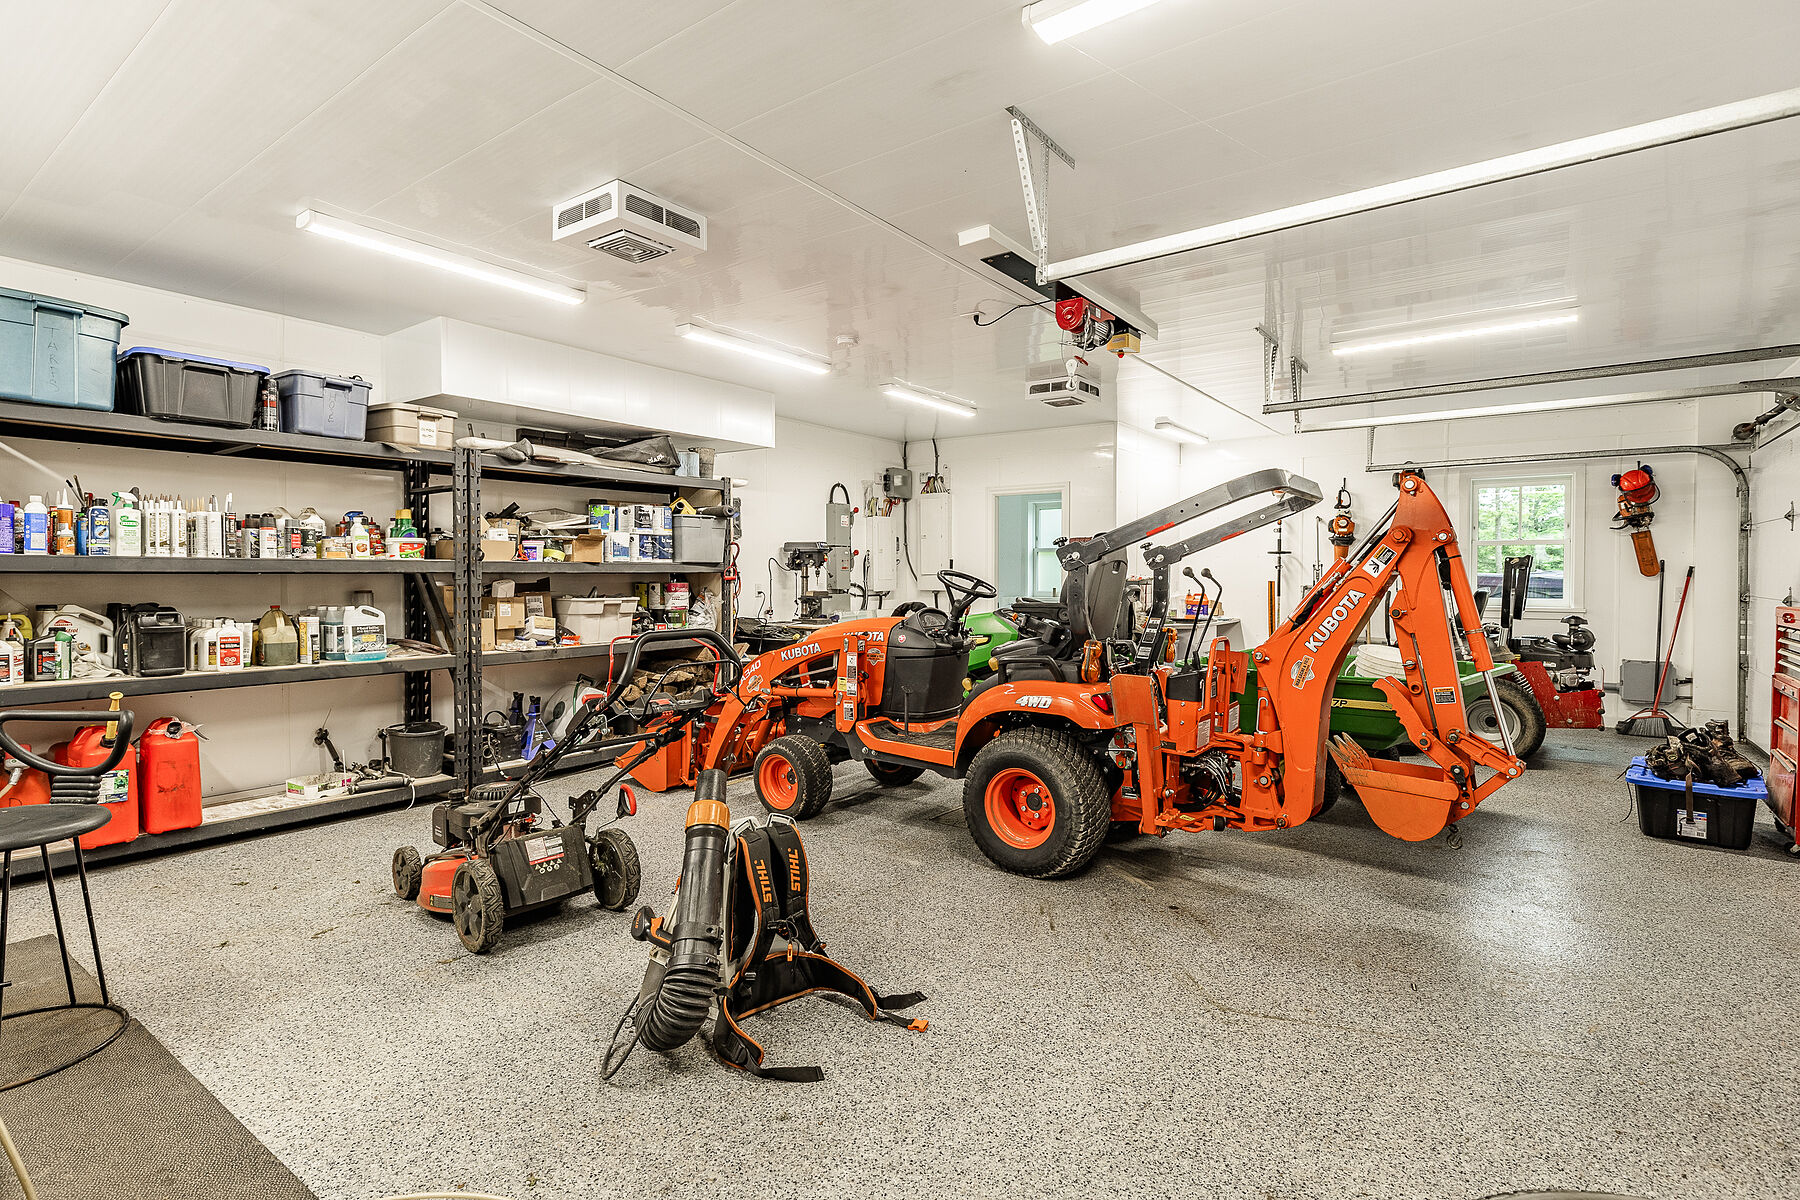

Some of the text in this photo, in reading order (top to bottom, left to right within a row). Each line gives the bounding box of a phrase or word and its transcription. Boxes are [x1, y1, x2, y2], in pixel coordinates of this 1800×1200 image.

[1304, 588, 1367, 654] KUBOTA
[780, 642, 822, 662] KUBOTA
[1015, 695, 1053, 709] 4WD
[1332, 699, 1348, 708] 7P
[755, 859, 773, 903] STIHL
[788, 848, 801, 892] STIHL
